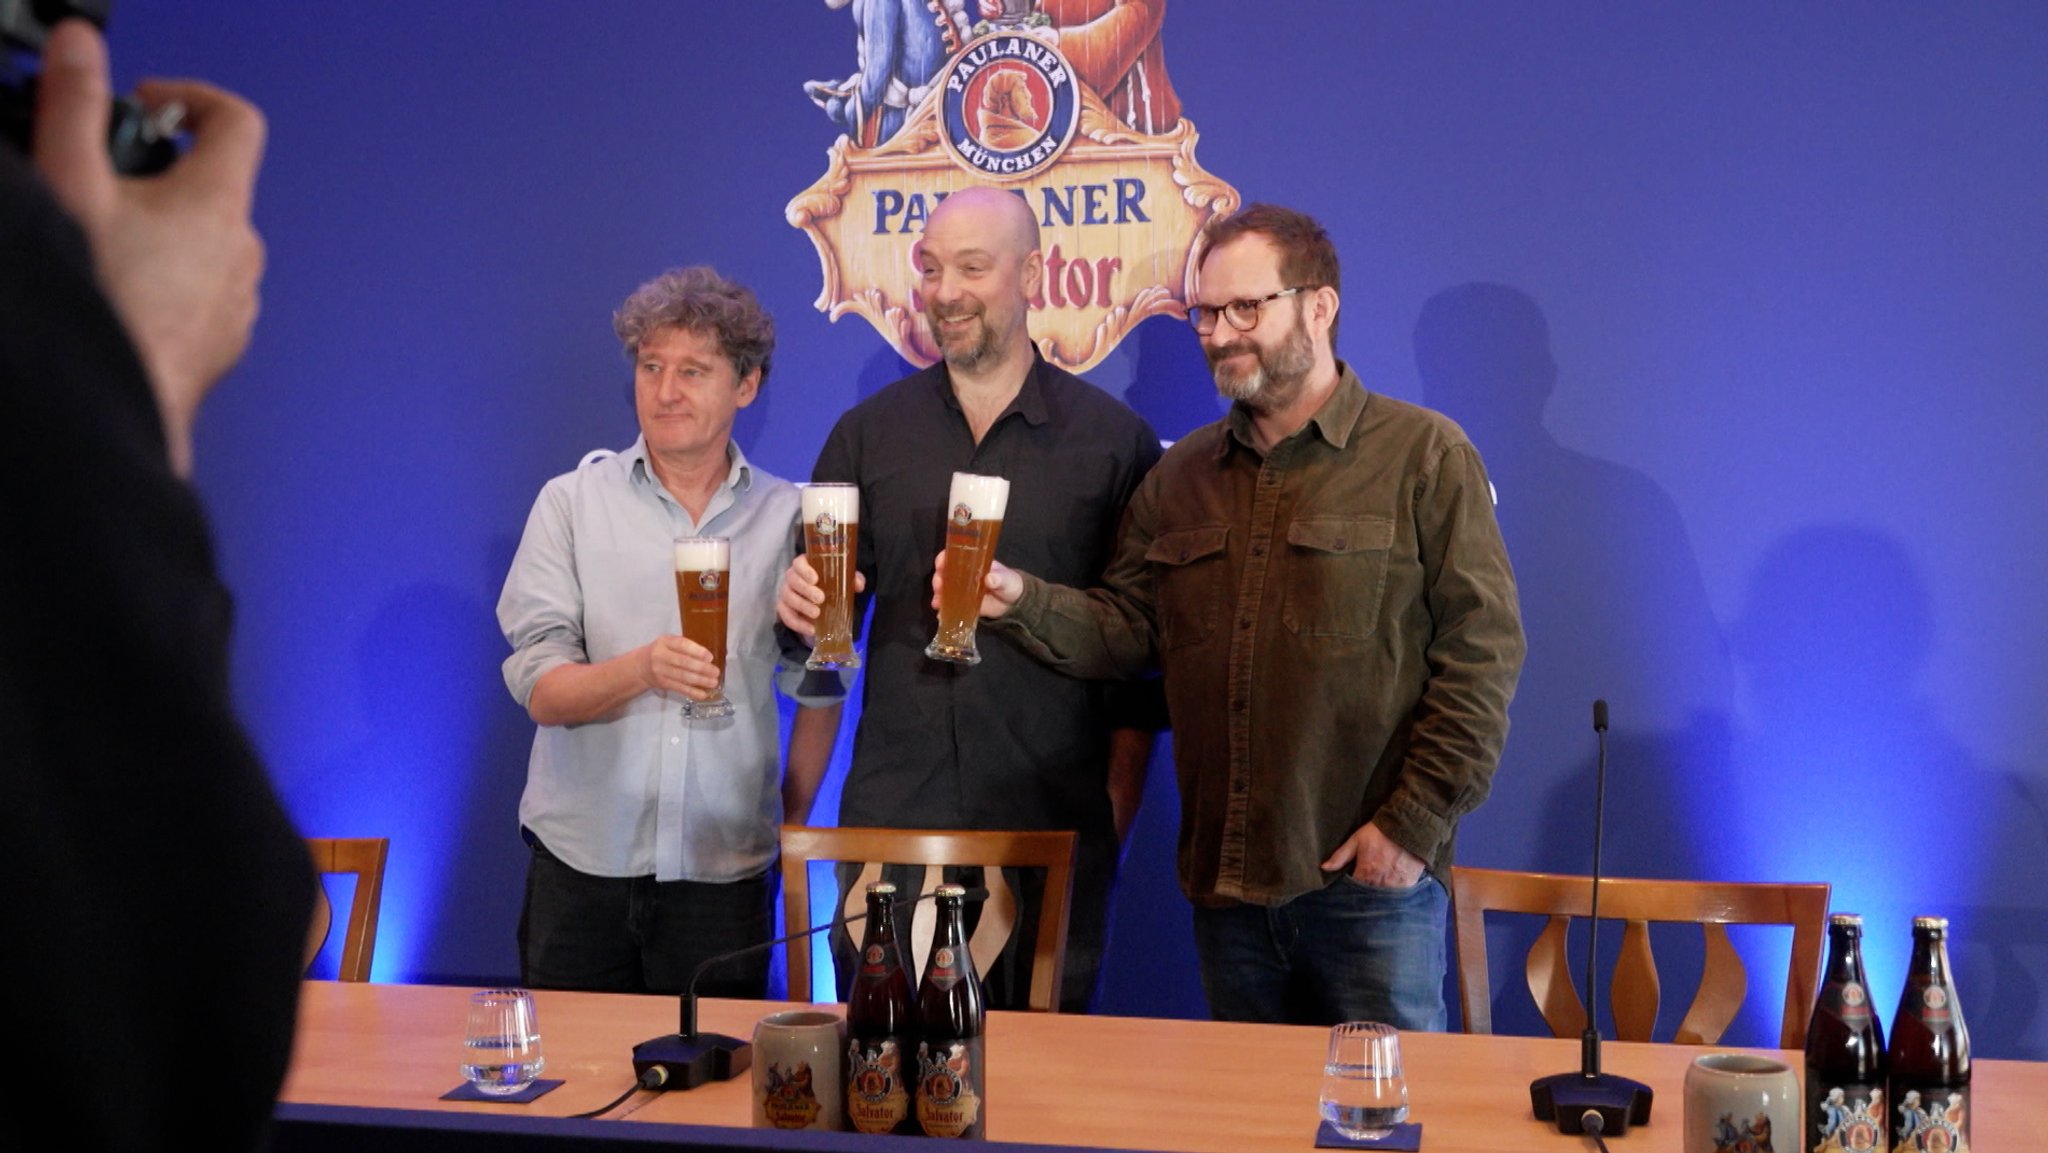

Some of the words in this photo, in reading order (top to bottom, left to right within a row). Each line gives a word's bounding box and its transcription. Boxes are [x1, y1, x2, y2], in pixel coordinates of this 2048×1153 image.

[947, 38, 1067, 92] PAULANER
[957, 136, 1057, 173] MÜNCHEN
[872, 178, 1151, 234] PANER
[856, 1102, 894, 1119] Salvator
[925, 1106, 964, 1123] Salvator
